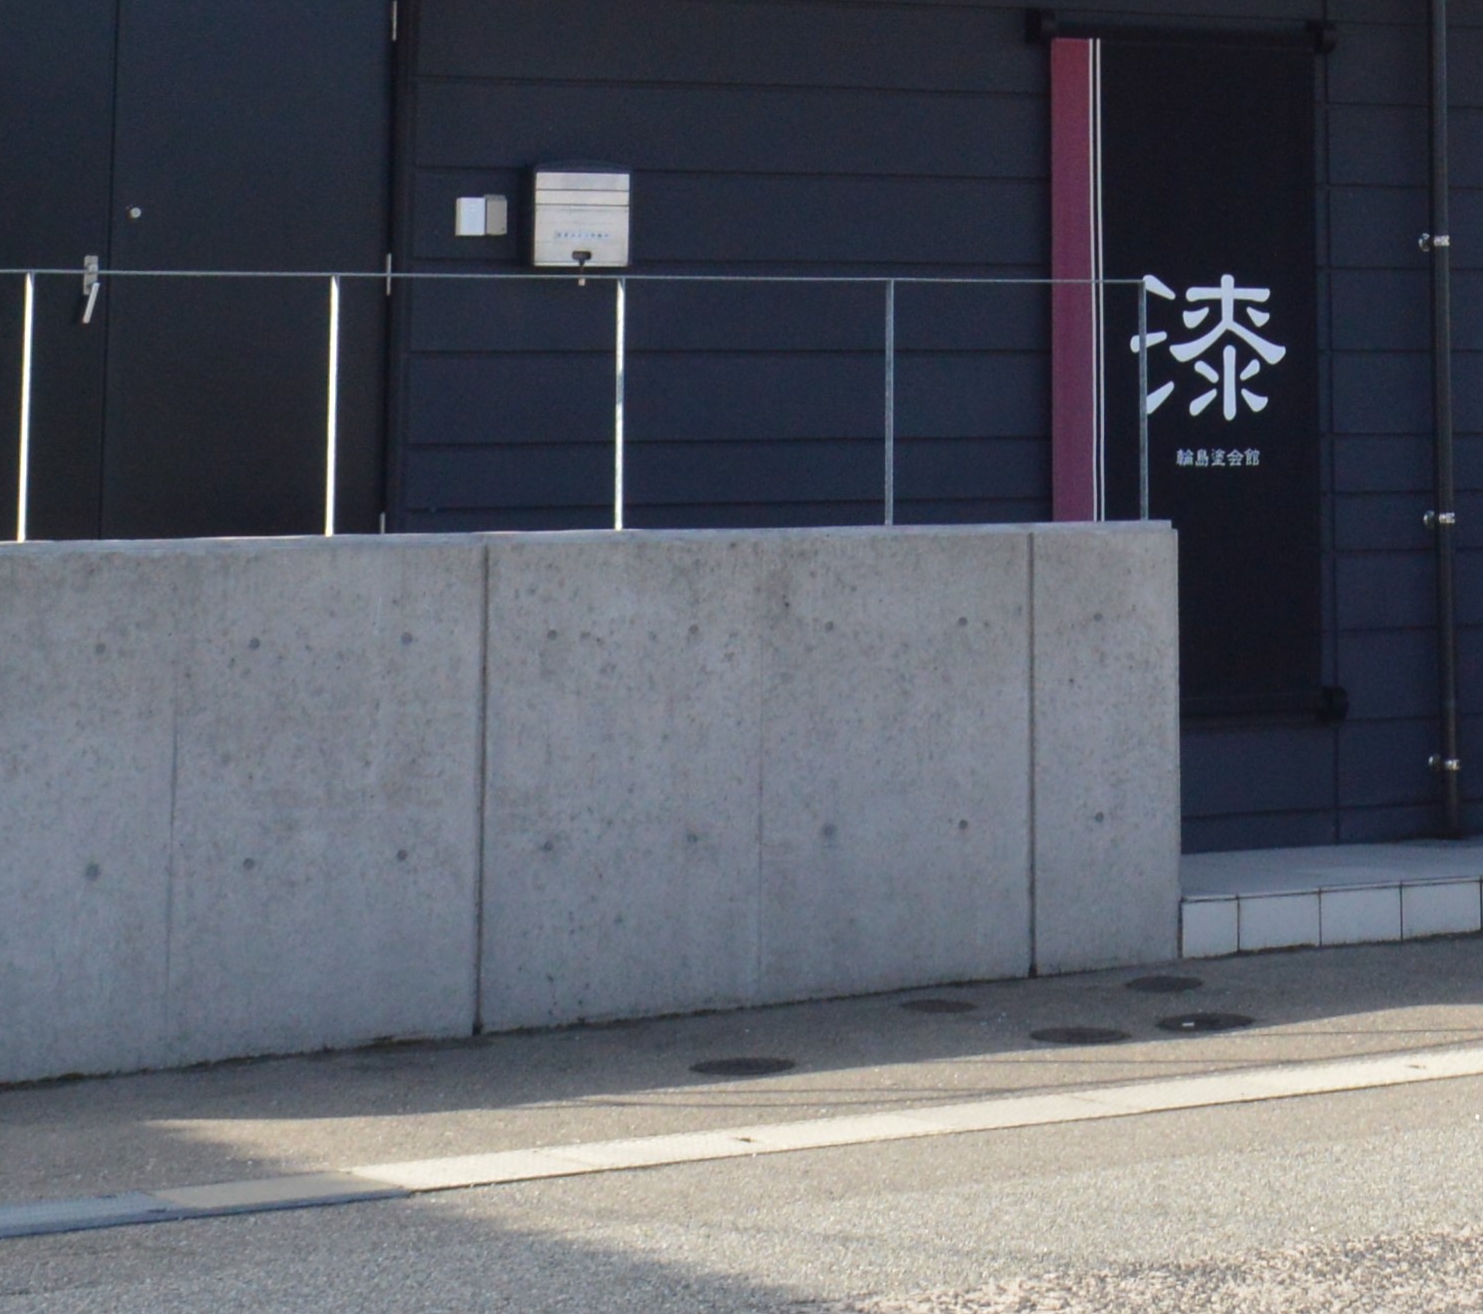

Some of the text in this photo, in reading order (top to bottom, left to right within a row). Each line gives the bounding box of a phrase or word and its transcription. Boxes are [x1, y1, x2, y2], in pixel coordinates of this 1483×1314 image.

[1130, 274, 1286, 421] 漆
[1176, 447, 1260, 467] 輪島塗会館
